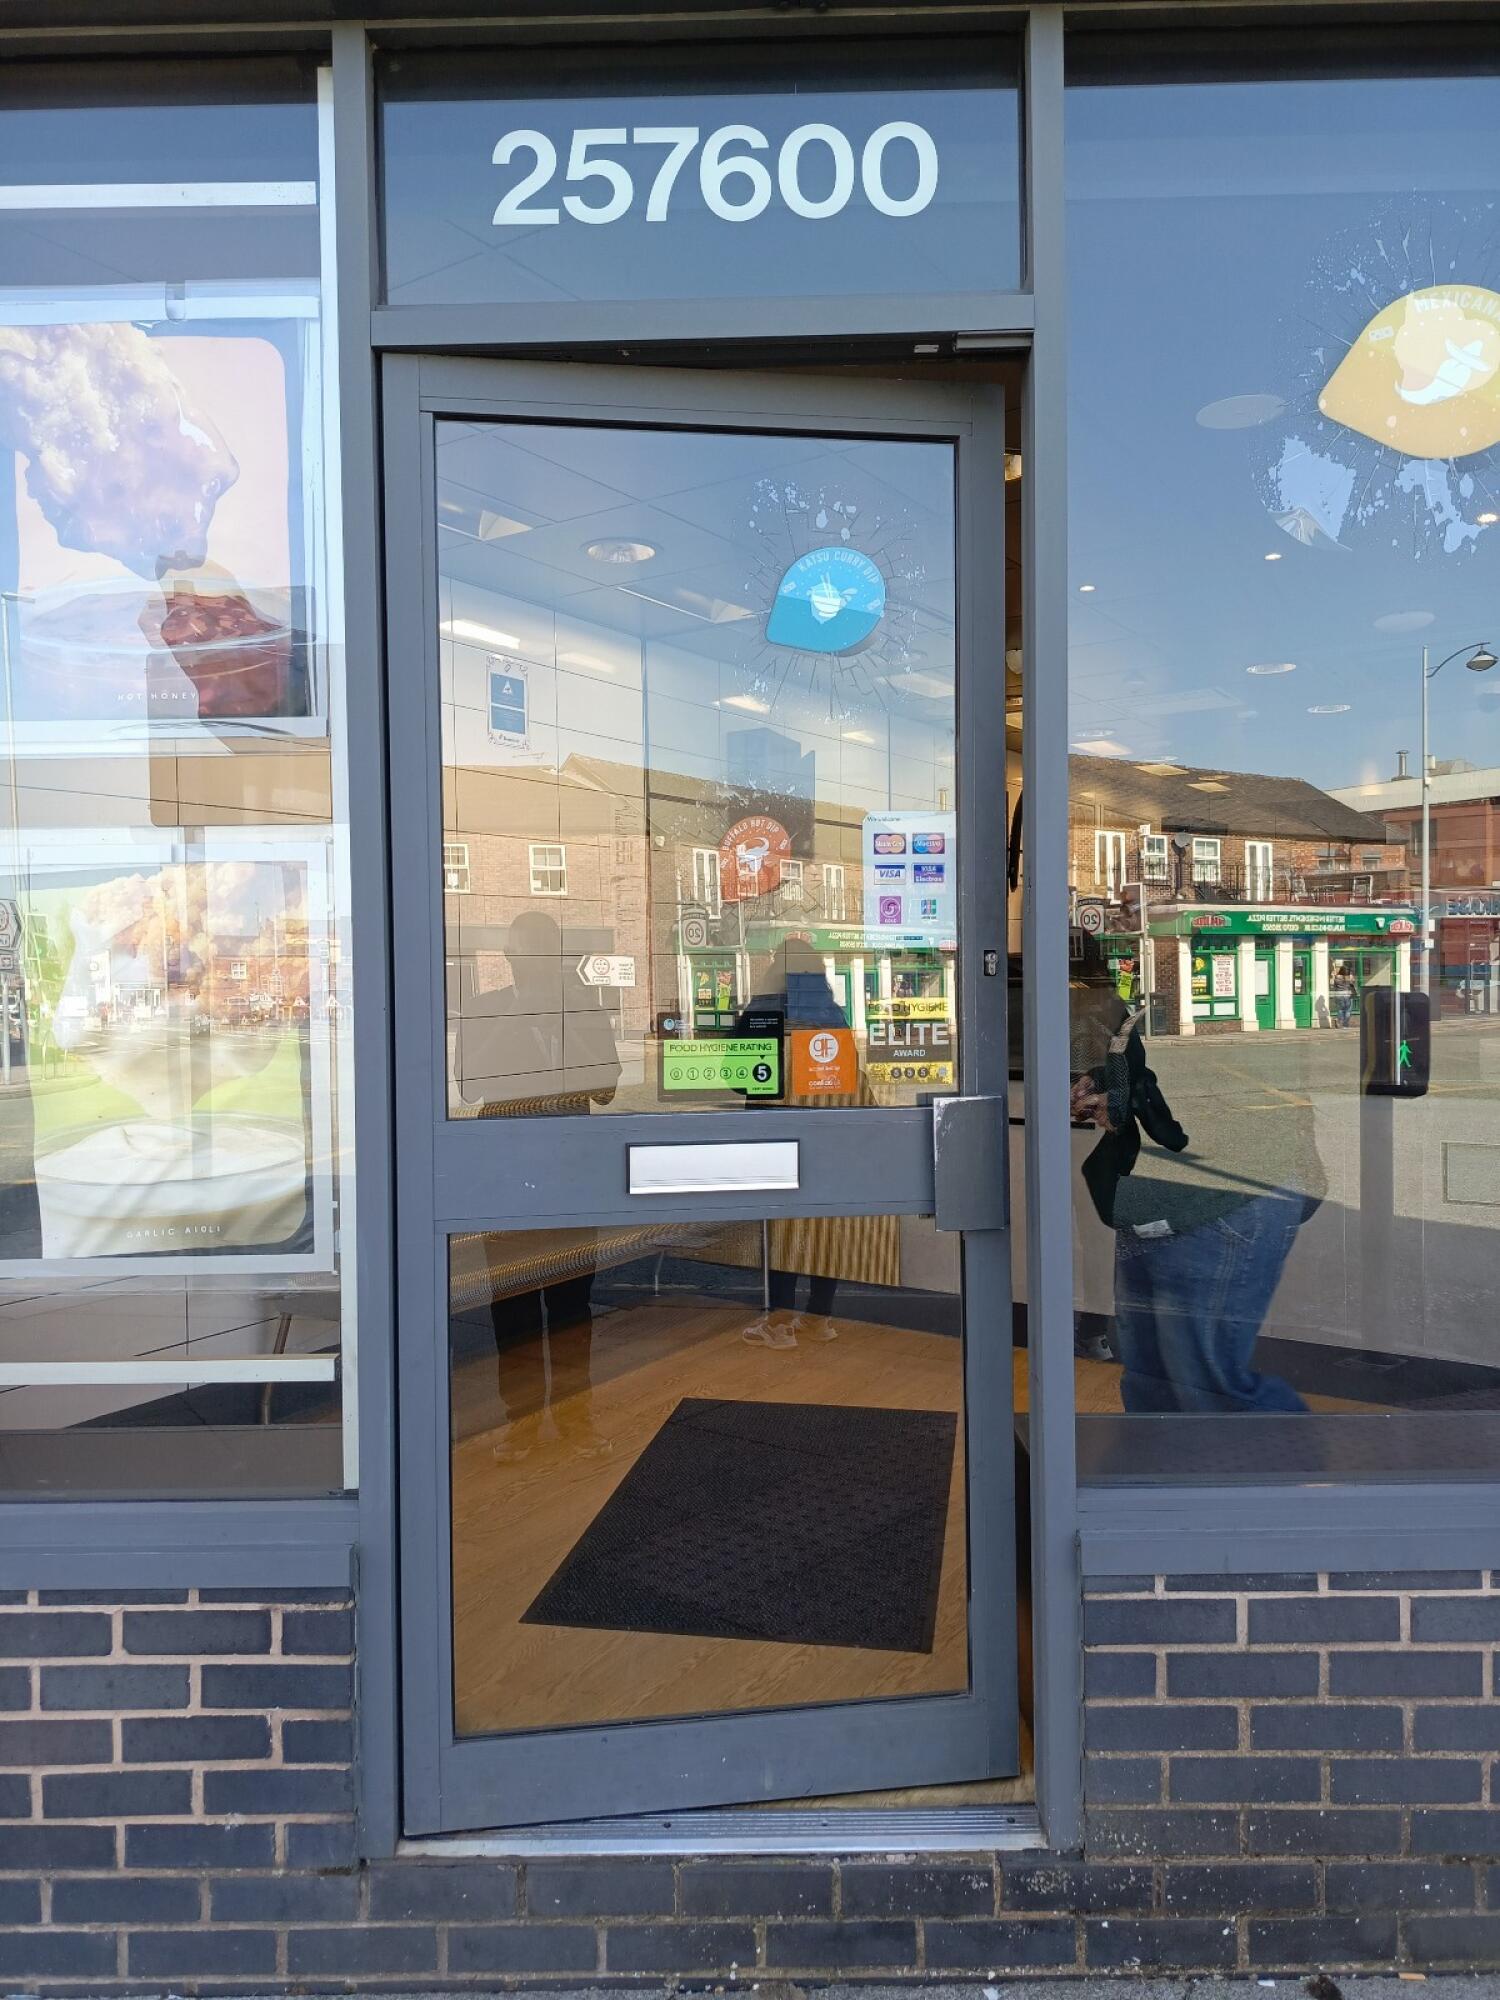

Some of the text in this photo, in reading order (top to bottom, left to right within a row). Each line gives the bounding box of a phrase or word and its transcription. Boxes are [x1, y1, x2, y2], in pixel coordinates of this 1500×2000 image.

[491, 120, 939, 226] 257600
[799, 550, 880, 584] KATSU CURRY DIP
[118, 691, 196, 701] HOT HONEY
[722, 819, 780, 851] BUFFALO HOT DIP
[879, 869, 901, 878] VISA
[903, 1002, 949, 1012] HYGIENE
[869, 1023, 950, 1046] ELITE
[669, 1043, 772, 1053] FOOD HYGIENE RATING
[893, 1049, 926, 1057] AWARD
[127, 1225, 221, 1238] GARLIC AIOLI
